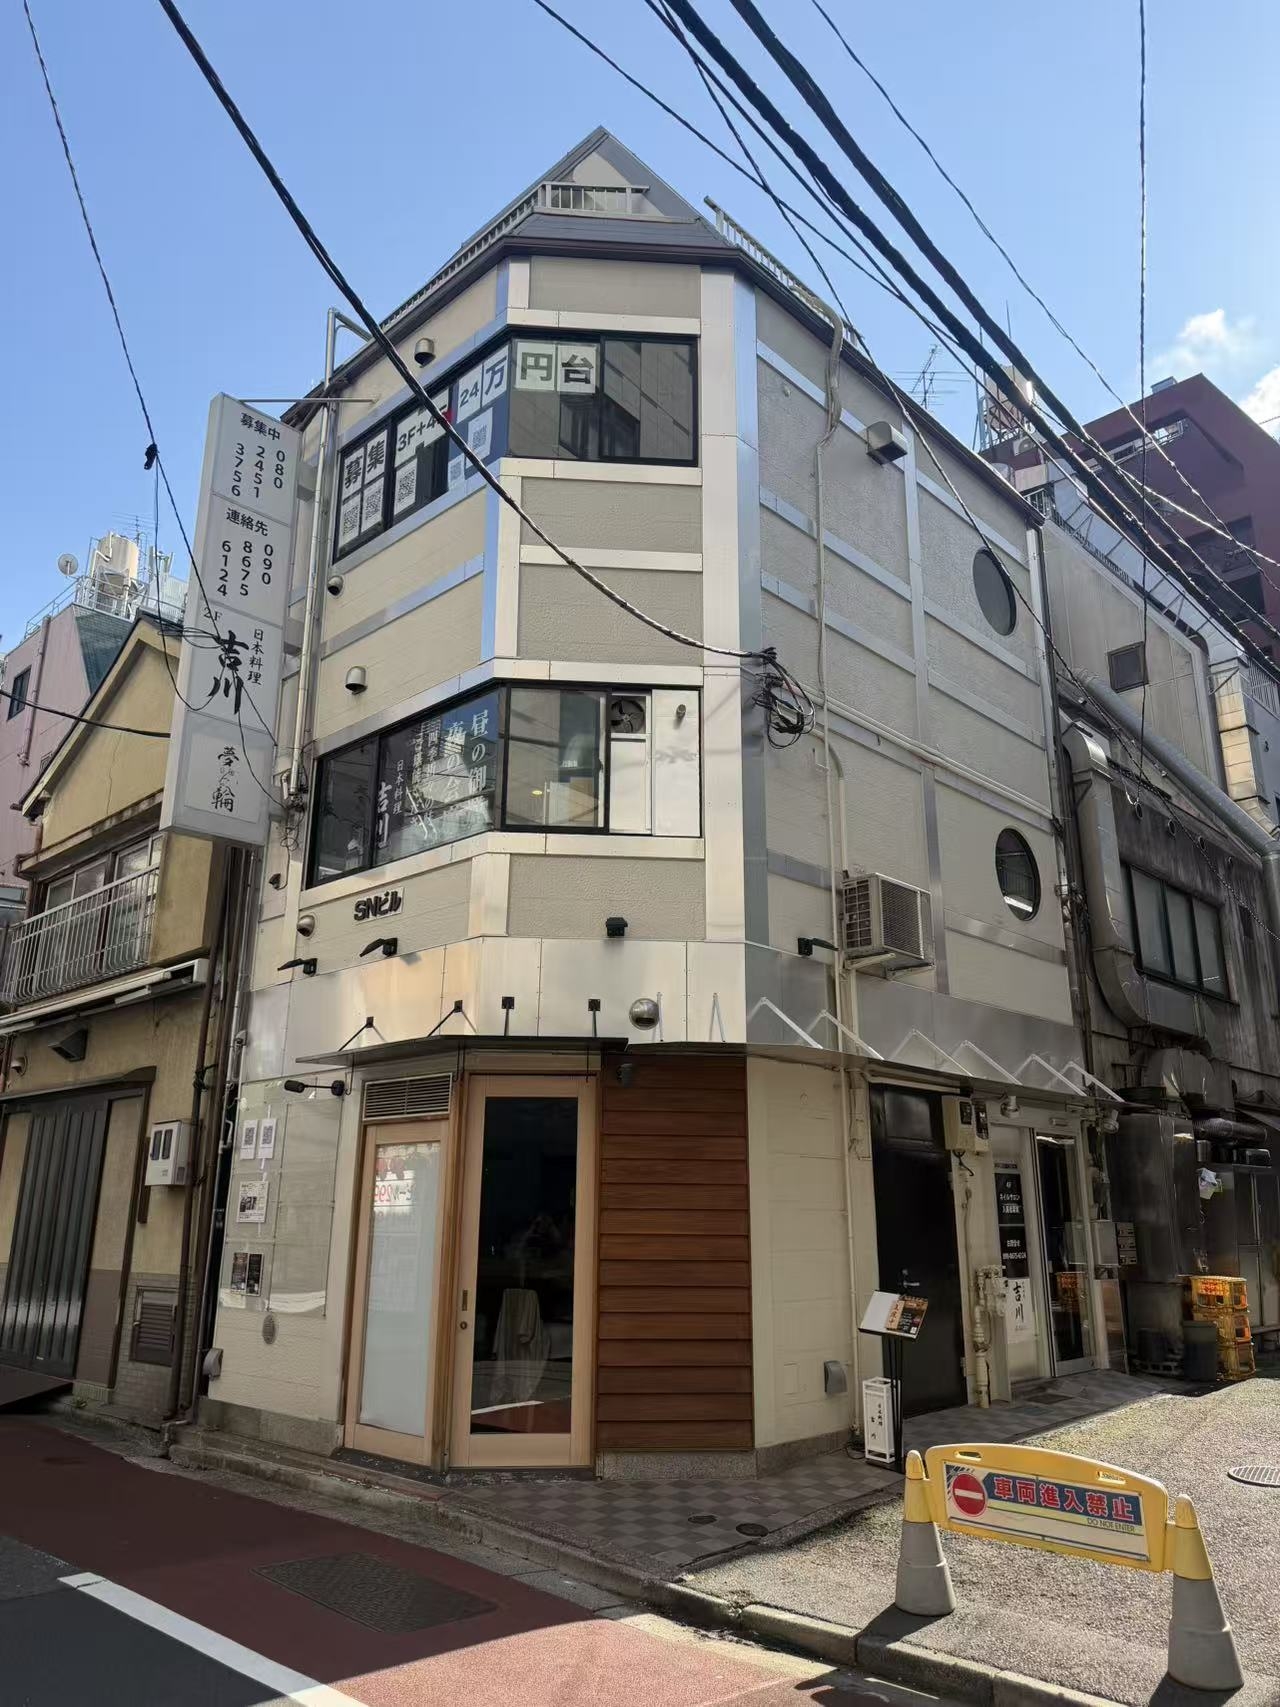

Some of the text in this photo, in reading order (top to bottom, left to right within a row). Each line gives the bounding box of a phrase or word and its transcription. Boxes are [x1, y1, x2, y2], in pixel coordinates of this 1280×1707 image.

[240, 412, 281, 441] 募集中
[397, 404, 448, 453] 3F+4
[344, 440, 385, 489] 募集
[225, 507, 269, 537] 連絡先
[208, 629, 250, 715] 吉川
[246, 628, 265, 686] 日本料理
[353, 890, 402, 921] SNビル
[993, 1477, 1134, 1521] 車両進入禁止
